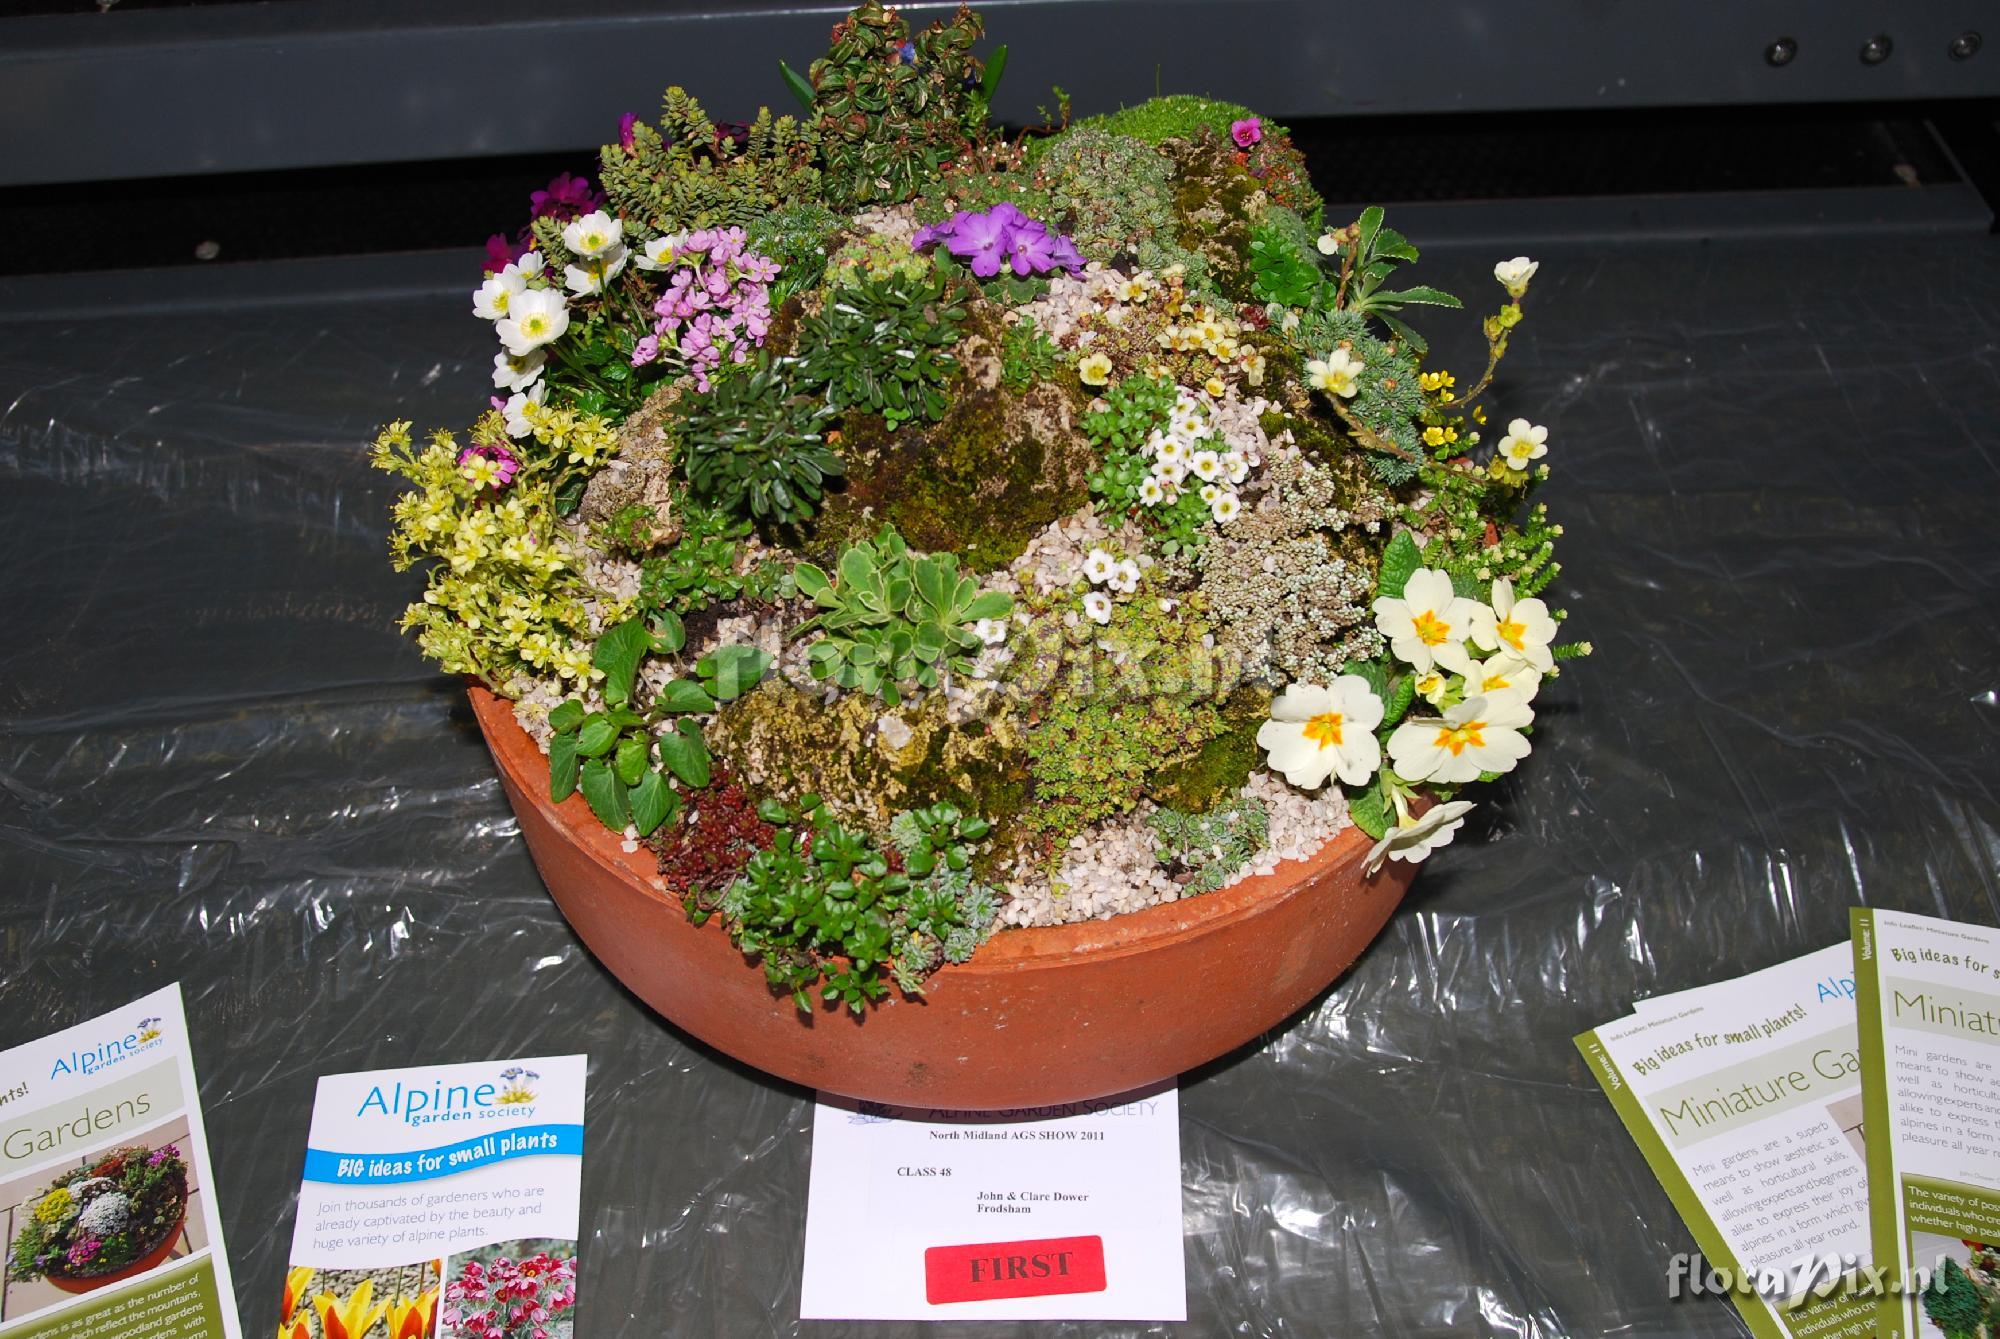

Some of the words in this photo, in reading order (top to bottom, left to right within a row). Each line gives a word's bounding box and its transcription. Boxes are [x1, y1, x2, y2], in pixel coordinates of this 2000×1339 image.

[1892, 948, 1917, 963] Big
[1920, 948, 1958, 966] ideas
[1965, 956, 1989, 973] for
[1816, 971, 1856, 1003] Alp
[1894, 990, 2000, 1036] Miniat
[1632, 1058, 1660, 1076] Big
[1654, 1040, 1694, 1063] ideas
[1694, 1032, 1718, 1048] for
[1724, 1027, 1762, 1044] small
[1764, 1003, 1808, 1039] plants!
[51, 1034, 137, 1080] Alpine
[87, 1055, 126, 1076] garden
[130, 1038, 164, 1056] society
[1895, 1044, 1917, 1057] Mini
[1926, 1052, 1968, 1066] gardens
[1976, 1062, 1992, 1071] are
[1896, 1061, 1932, 1073] means
[1938, 1066, 1948, 1076] to
[1954, 1070, 1984, 1083] show
[1898, 1074, 1920, 1085] well
[1930, 1080, 1942, 1088] as
[357, 1080, 496, 1123] Alpine
[1082, 1100, 1158, 1116] SOCIETY
[1660, 1070, 1811, 1136] Miniature
[1898, 1088, 1943, 1105] allowing
[1944, 1096, 1983, 1111] experts
[4, 1094, 151, 1160] Gardens
[412, 1110, 472, 1127] garden
[479, 1105, 536, 1120] society
[1900, 1102, 1924, 1114] alike
[1930, 1107, 1942, 1116] to
[1948, 1112, 1989, 1126] express
[929, 1130, 960, 1140] North
[963, 1130, 1008, 1140] Midland
[1010, 1130, 1036, 1140] AGS
[1038, 1130, 1078, 1140] SHOW
[1080, 1131, 1104, 1141] 2011
[1900, 1118, 1938, 1131] alpines
[1942, 1124, 1952, 1133] in
[1957, 1128, 1963, 1136] a
[1967, 1128, 1994, 1142] form
[1902, 1131, 1948, 1148] pleasure
[1952, 1140, 1962, 1150] all
[1966, 1144, 1990, 1155] year
[336, 1158, 365, 1178] BIG
[368, 1156, 412, 1177] ideas
[417, 1154, 444, 1174] for
[448, 1136, 496, 1167] small
[500, 1132, 558, 1157] plants
[1692, 1162, 1716, 1176] Mini
[1721, 1147, 1758, 1170] gardens
[1764, 1140, 1780, 1152] are
[1786, 1136, 1792, 1144] a
[1796, 1122, 1829, 1142] superb
[897, 1167, 937, 1177] CLASS
[940, 1168, 952, 1177] 48
[1704, 1174, 1736, 1192] means
[1738, 1168, 1750, 1178] to
[1754, 1156, 1780, 1173] show
[1784, 1142, 1824, 1162] aesthetic
[1828, 1136, 1840, 1146] as
[1712, 1191, 1734, 1206] well
[1742, 1186, 1754, 1195] as
[1760, 1161, 1817, 1188] horticultural
[1824, 1151, 1849, 1166] skills.
[318, 1202, 341, 1216] Join
[345, 1196, 406, 1212] thousands
[411, 1194, 424, 1206] of
[427, 1189, 488, 1208] gardeners
[492, 1186, 521, 1200] who
[524, 1186, 544, 1197] are
[977, 1192, 1004, 1201] John
[1007, 1192, 1016, 1201] &
[1020, 1192, 1050, 1201] Clare
[1053, 1192, 1089, 1202] Dower
[977, 1204, 1032, 1214] Frodsham
[1908, 1186, 1929, 1198] The
[1932, 1192, 1964, 1206] variety
[1968, 1198, 1978, 1206] of
[315, 1217, 360, 1233] already
[363, 1210, 426, 1229] captivated
[430, 1209, 444, 1224] by
[449, 1207, 468, 1220] the
[473, 1204, 516, 1220] beauty
[518, 1202, 542, 1216] and
[1731, 1222, 1754, 1238] alike
[1756, 1216, 1769, 1226] to
[1773, 1203, 1810, 1221] express
[1812, 1190, 1834, 1206] their
[1838, 1186, 1854, 1199] joy
[1910, 1200, 1960, 1217] individuals
[1962, 1210, 1985, 1222] who
[1910, 1215, 1954, 1228] whether
[1956, 1220, 1978, 1234] high
[313, 1236, 344, 1252] huge
[347, 1232, 390, 1246] variety
[392, 1230, 406, 1242] of
[408, 1228, 445, 1244] alpine
[448, 1226, 489, 1241] plants.
[1741, 1233, 1776, 1252] alpines
[1777, 1227, 1788, 1238] in
[1790, 1226, 1796, 1234] a
[1800, 1215, 1822, 1231] form
[1824, 1202, 1853, 1220] which
[1750, 1245, 1792, 1268] pleasure
[1794, 1237, 1804, 1250] all
[1806, 1232, 1826, 1248] year
[1828, 1219, 1861, 1238] round.
[970, 1252, 1074, 1284] FIRST
[72, 1319, 84, 1329] as
[85, 1308, 112, 1325] great
[114, 1304, 126, 1314] as
[128, 1296, 144, 1308] the
[148, 1282, 187, 1301] number
[188, 1272, 200, 1284] of
[165, 1302, 204, 1326] gardens
[1786, 1311, 1808, 1323] The
[1808, 1298, 1838, 1315] variety
[1839, 1292, 1849, 1303] of
[96, 1316, 128, 1334] reflect
[128, 1311, 146, 1322] the
[184, 1315, 206, 1330] with
[1796, 1313, 1842, 1337] individuals
[1840, 1305, 1862, 1320] who
[1843, 1322, 1864, 1336] high
